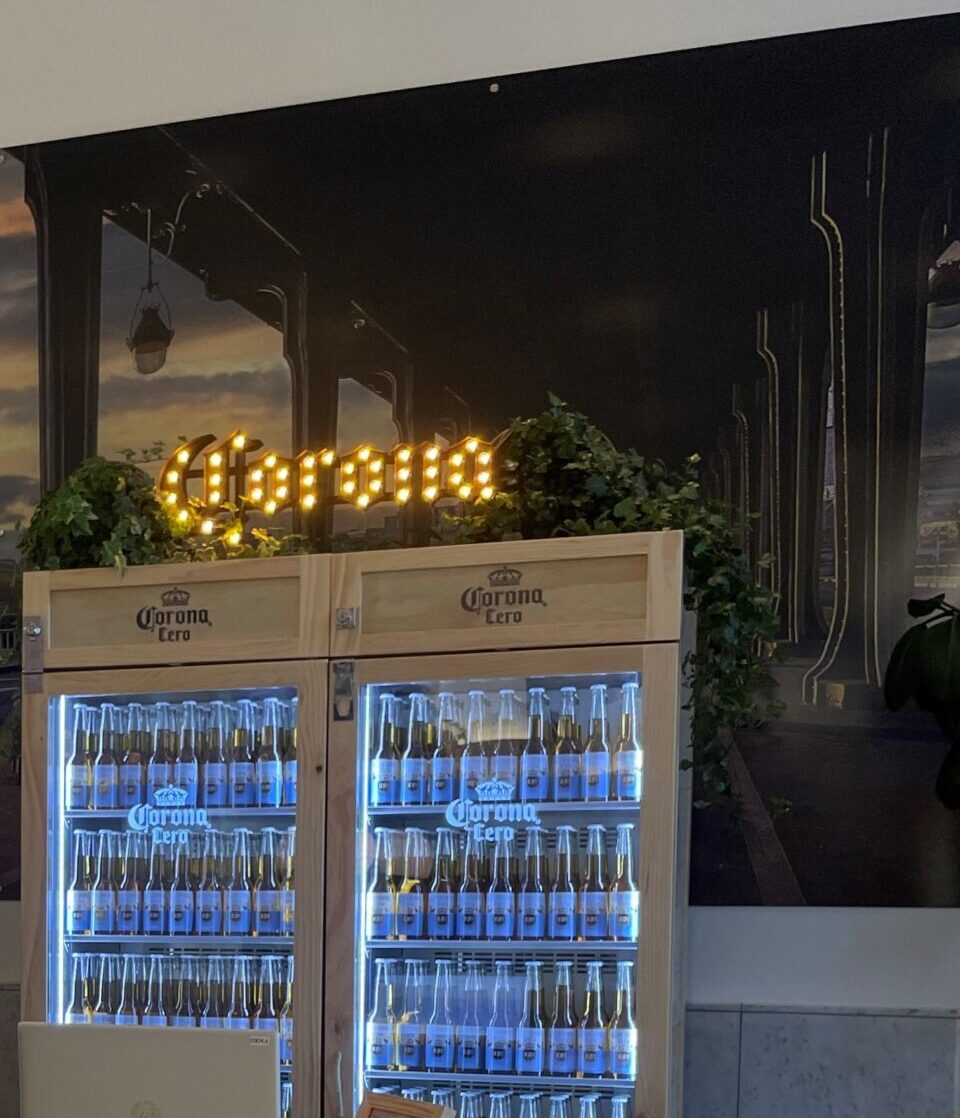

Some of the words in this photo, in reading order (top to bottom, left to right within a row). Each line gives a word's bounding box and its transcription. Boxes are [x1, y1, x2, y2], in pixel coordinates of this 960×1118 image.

[160, 429, 497, 540] Corona
[461, 586, 546, 615] Corona
[136, 605, 211, 633] Corona
[485, 608, 522, 625] Cero
[158, 627, 191, 642] Cero
[128, 803, 211, 834] Corona
[446, 798, 541, 831] Corona
[152, 826, 188, 845] Cero
[473, 823, 515, 842] Cero
